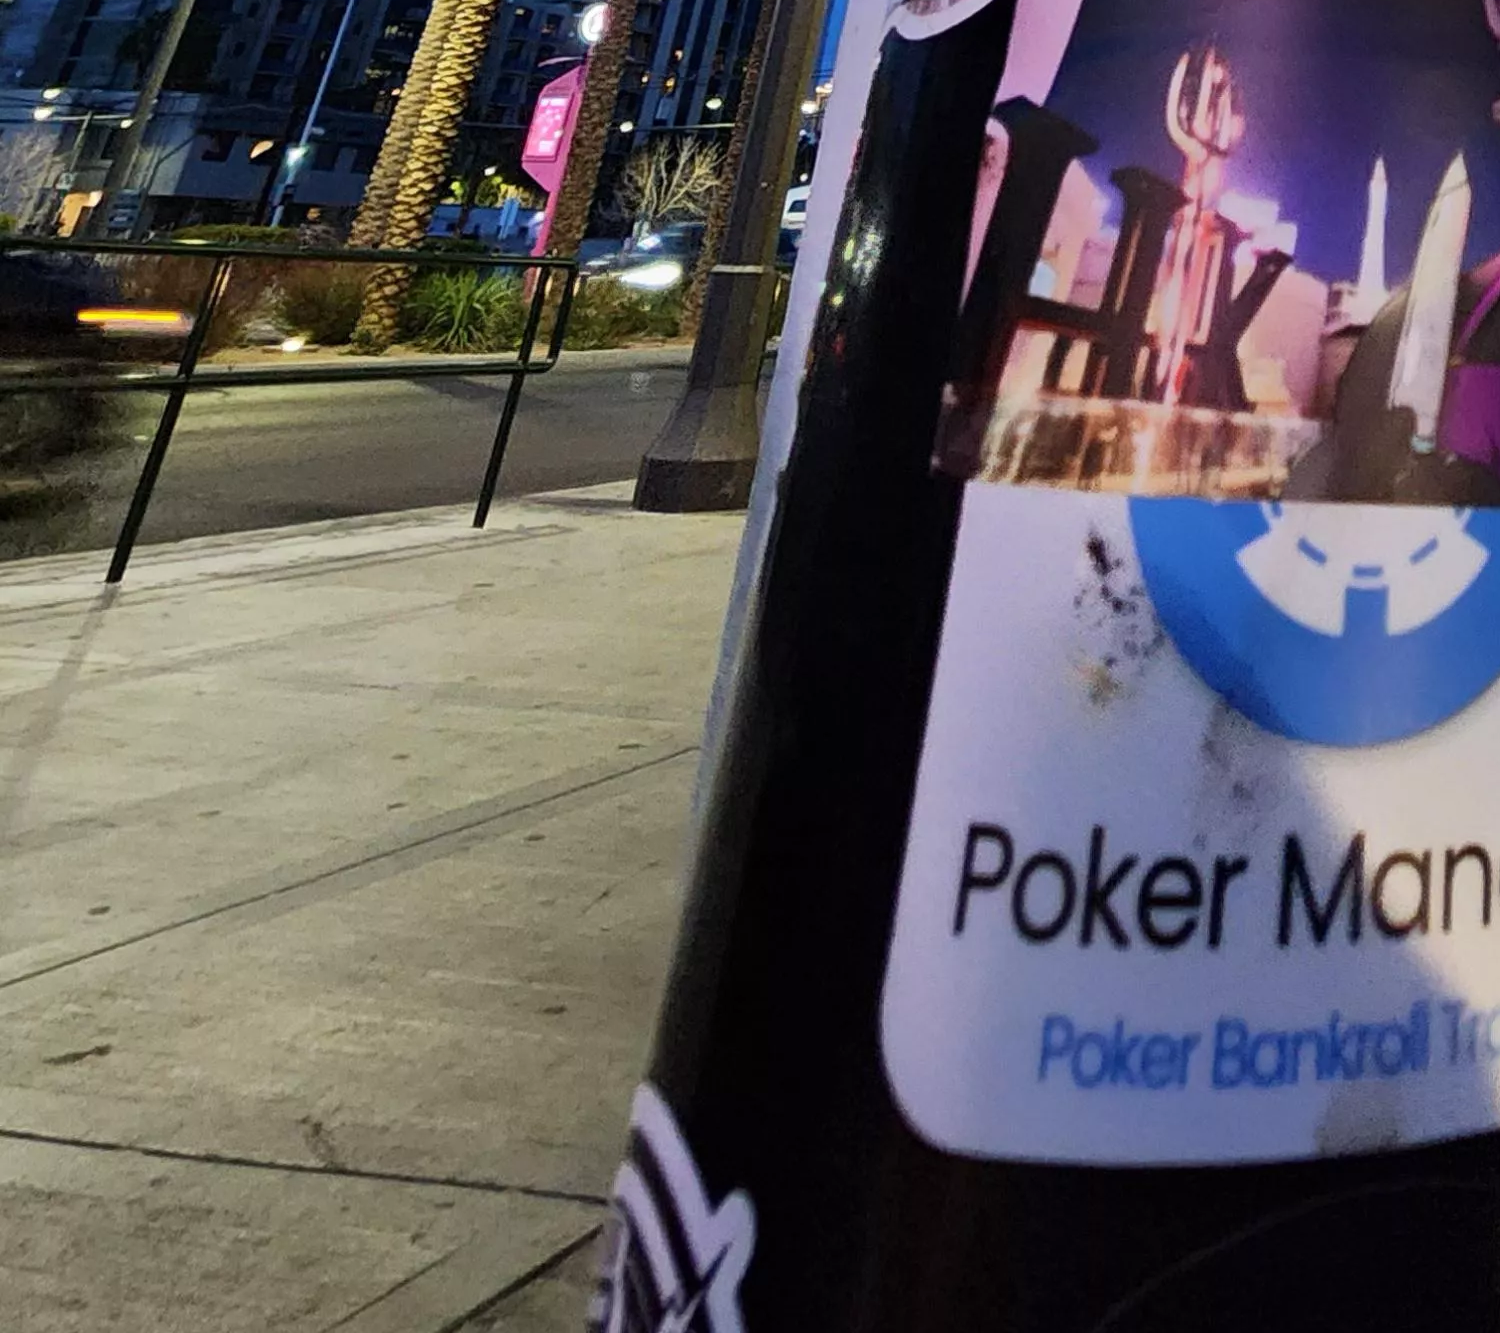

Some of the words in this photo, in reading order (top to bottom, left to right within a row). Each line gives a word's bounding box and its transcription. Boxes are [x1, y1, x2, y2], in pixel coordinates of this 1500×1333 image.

[951, 818, 1248, 950] Poker
[1037, 1010, 1199, 1090] Poker
[1213, 998, 1430, 1090] Bankroll
